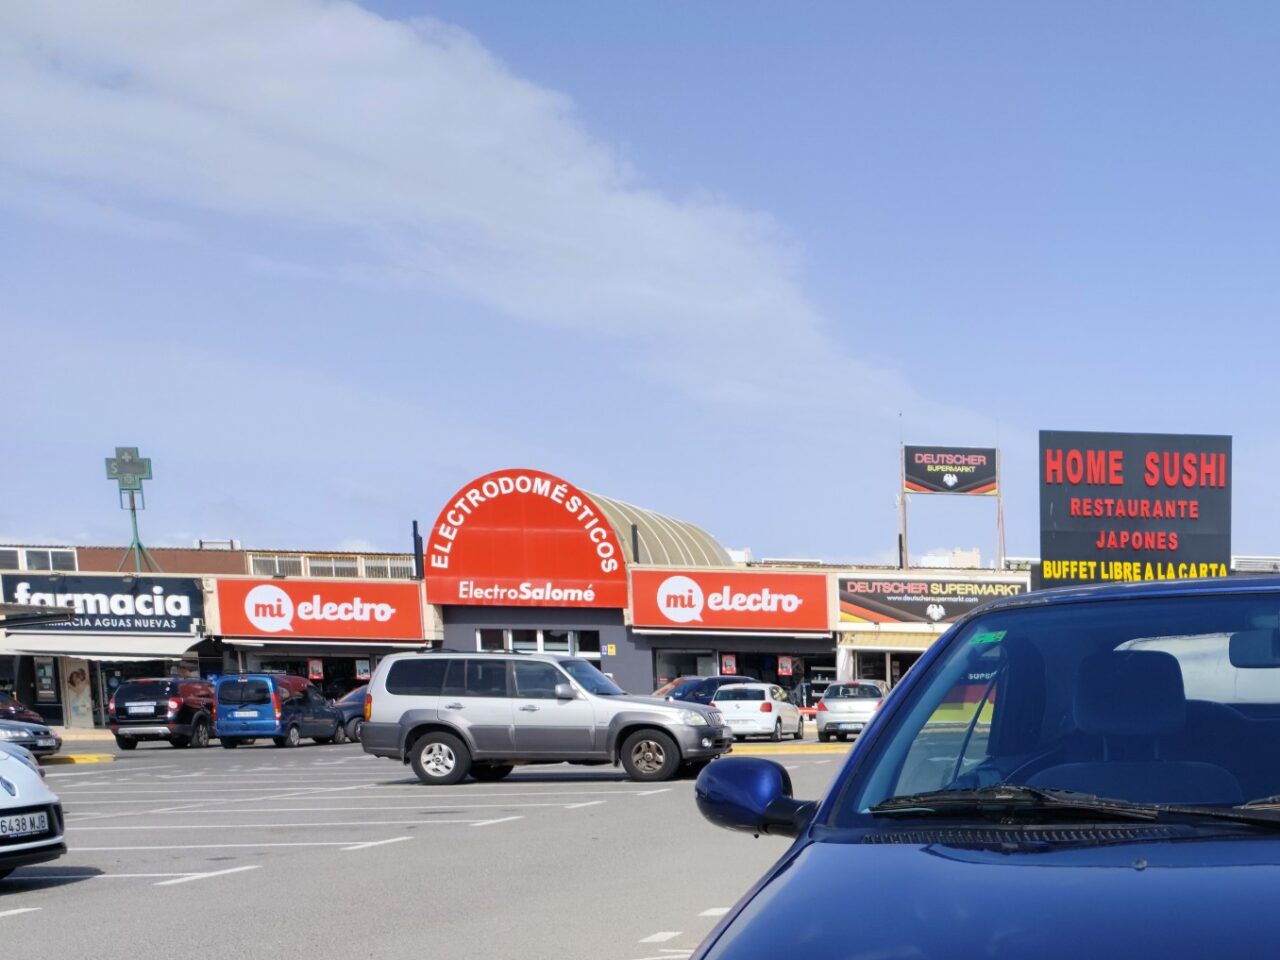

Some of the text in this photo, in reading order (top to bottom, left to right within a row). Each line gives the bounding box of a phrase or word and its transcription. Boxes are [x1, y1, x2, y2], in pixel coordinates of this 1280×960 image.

[914, 453, 986, 465] DEUTSCHER
[1045, 449, 1226, 488] HOME SUSHI
[1070, 498, 1199, 520] RESTAURANTE
[431, 475, 618, 573] ELECTRODOMÉSTICOS
[1096, 531, 1178, 551] JAPONES
[1043, 560, 1227, 582] BUFFET LIBRE A LA CARTA
[14, 582, 191, 616] farmacia
[665, 585, 803, 612] mi electro
[847, 581, 1021, 596] DEUTSCHER SUPERMARKT
[886, 594, 979, 603] www.deutschersupermarkt.com
[254, 595, 396, 622] mi electro
[95, 618, 132, 628] AGUAS
[135, 619, 177, 628] NUEVAS
[1, 818, 27, 833] 6438
